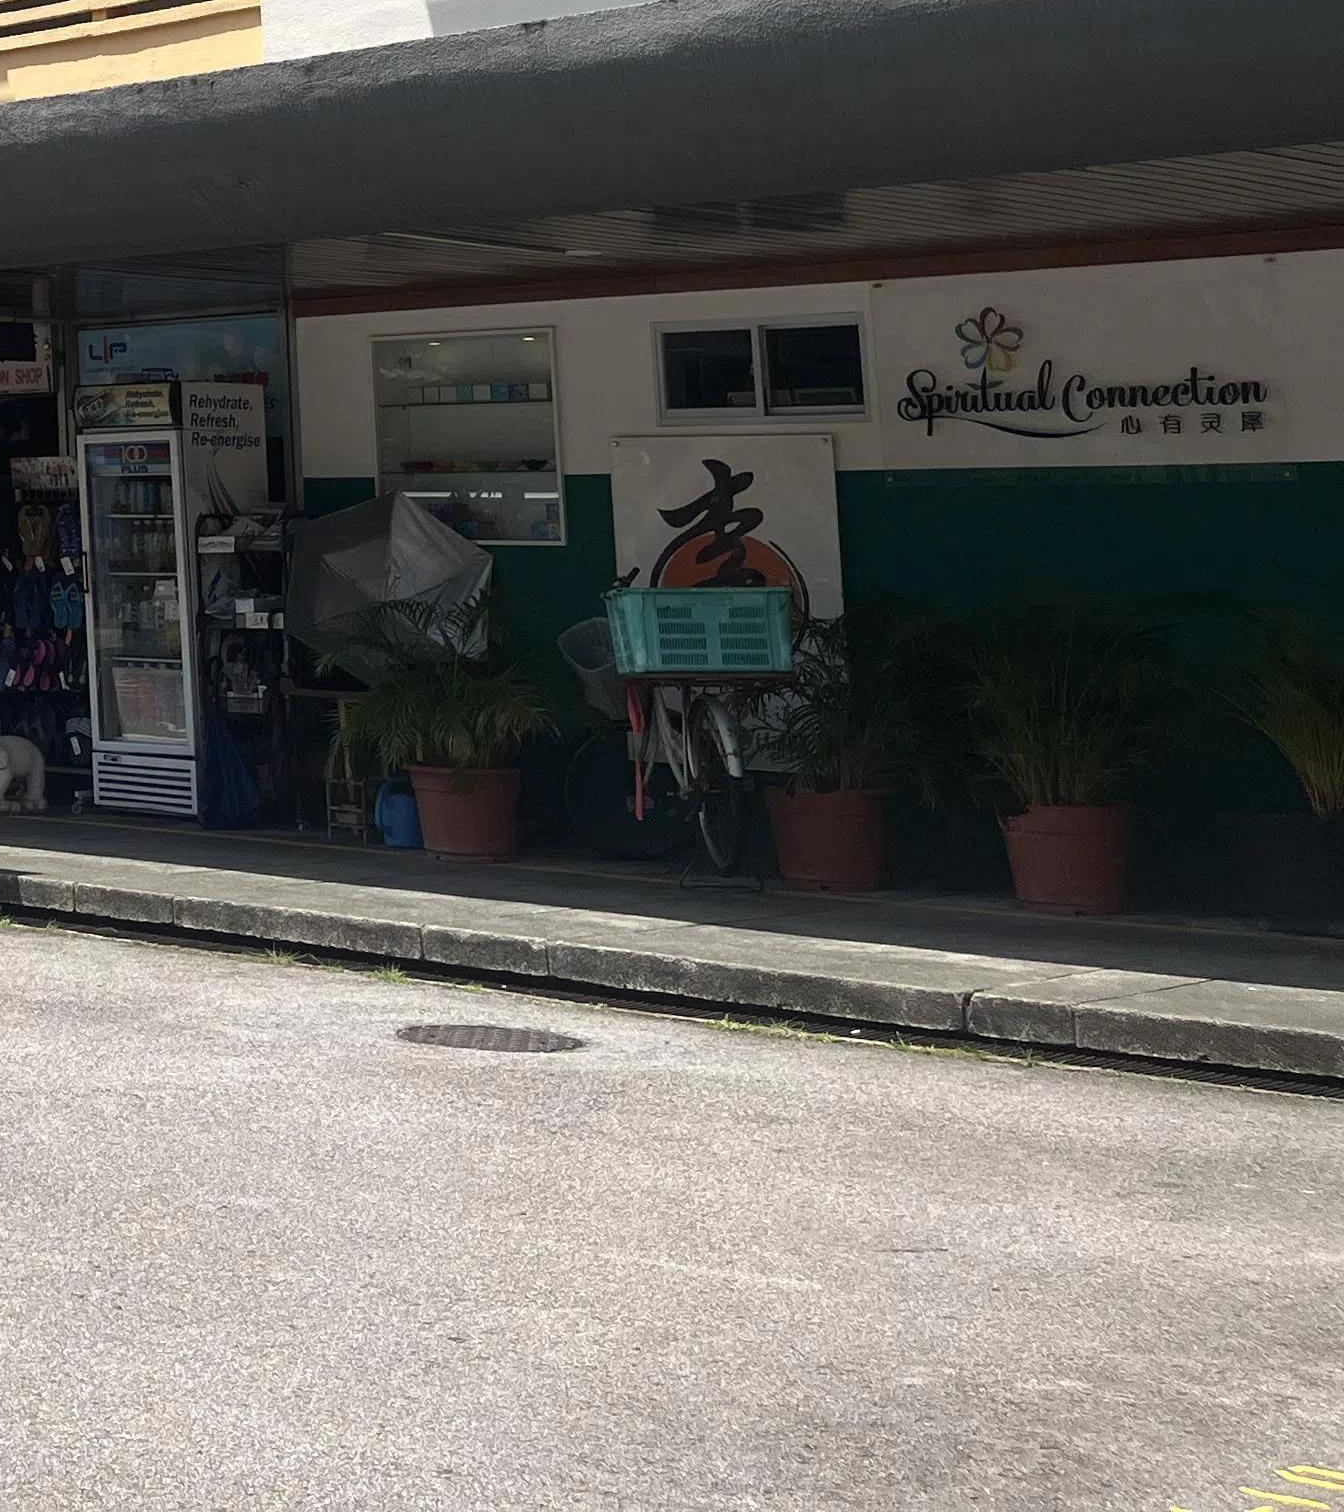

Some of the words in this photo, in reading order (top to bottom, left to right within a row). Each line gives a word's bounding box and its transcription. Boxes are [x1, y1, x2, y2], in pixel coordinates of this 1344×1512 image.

[15, 368, 42, 385] SHOP
[189, 394, 253, 413] Rehydrate,
[897, 359, 1055, 436] Spiritual
[1063, 366, 1267, 423] Connection
[190, 413, 240, 430] Refresh,
[191, 431, 261, 450] Re-energise
[120, 445, 148, 464] 100
[121, 464, 149, 474] PLUS
